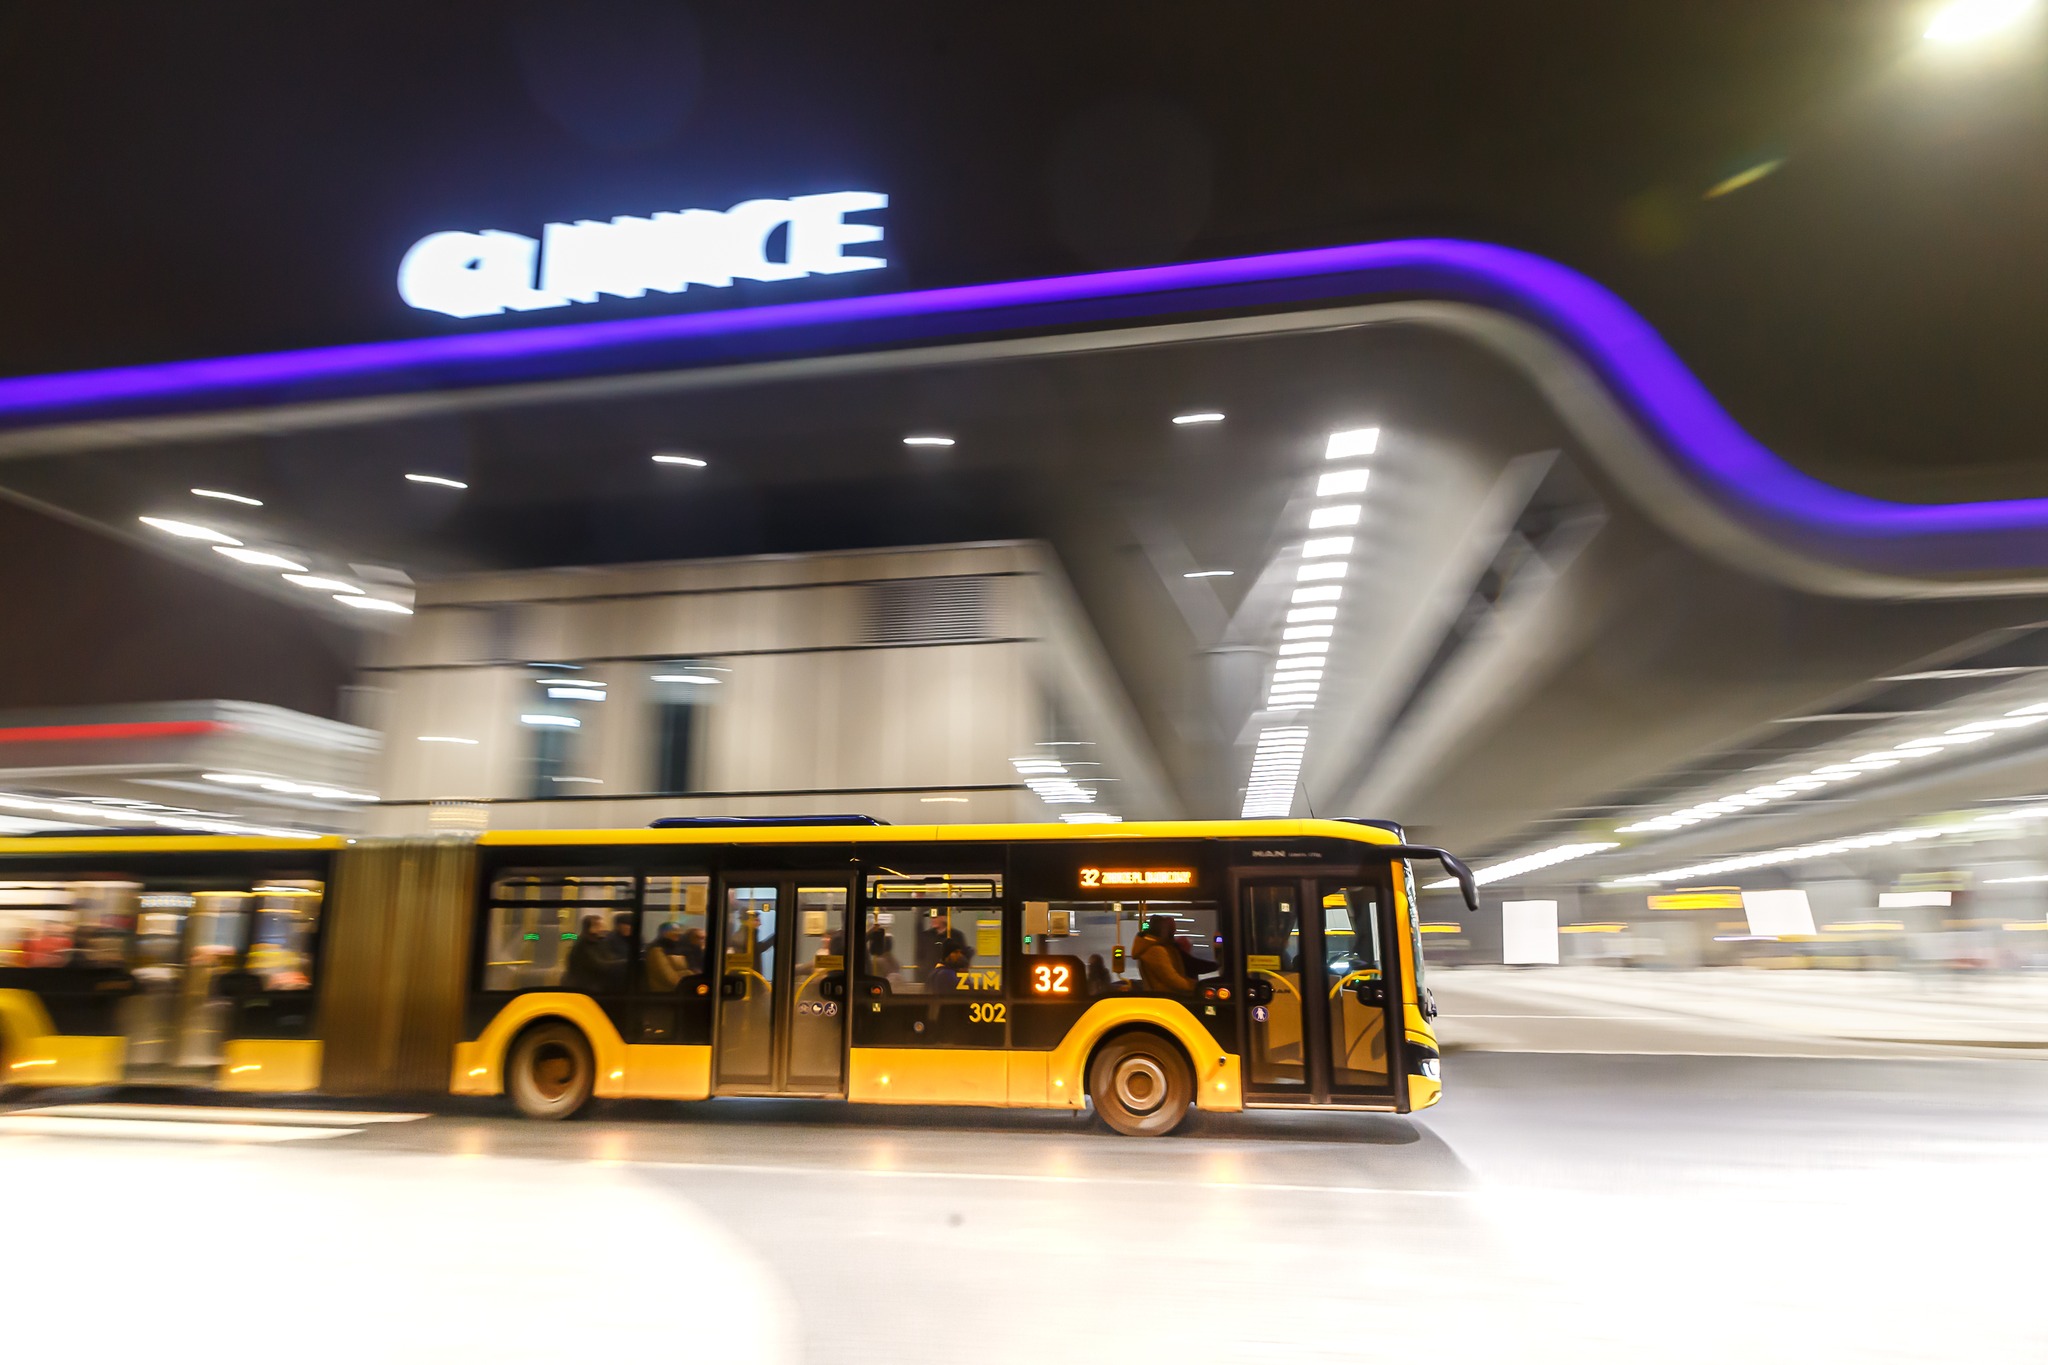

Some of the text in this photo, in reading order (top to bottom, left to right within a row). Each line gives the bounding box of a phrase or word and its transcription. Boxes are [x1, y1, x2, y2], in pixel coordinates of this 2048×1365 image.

[1080, 868, 1101, 887] 32
[955, 971, 1001, 991] ZTM
[1034, 965, 1070, 993] 32
[968, 1002, 1007, 1024] 302
